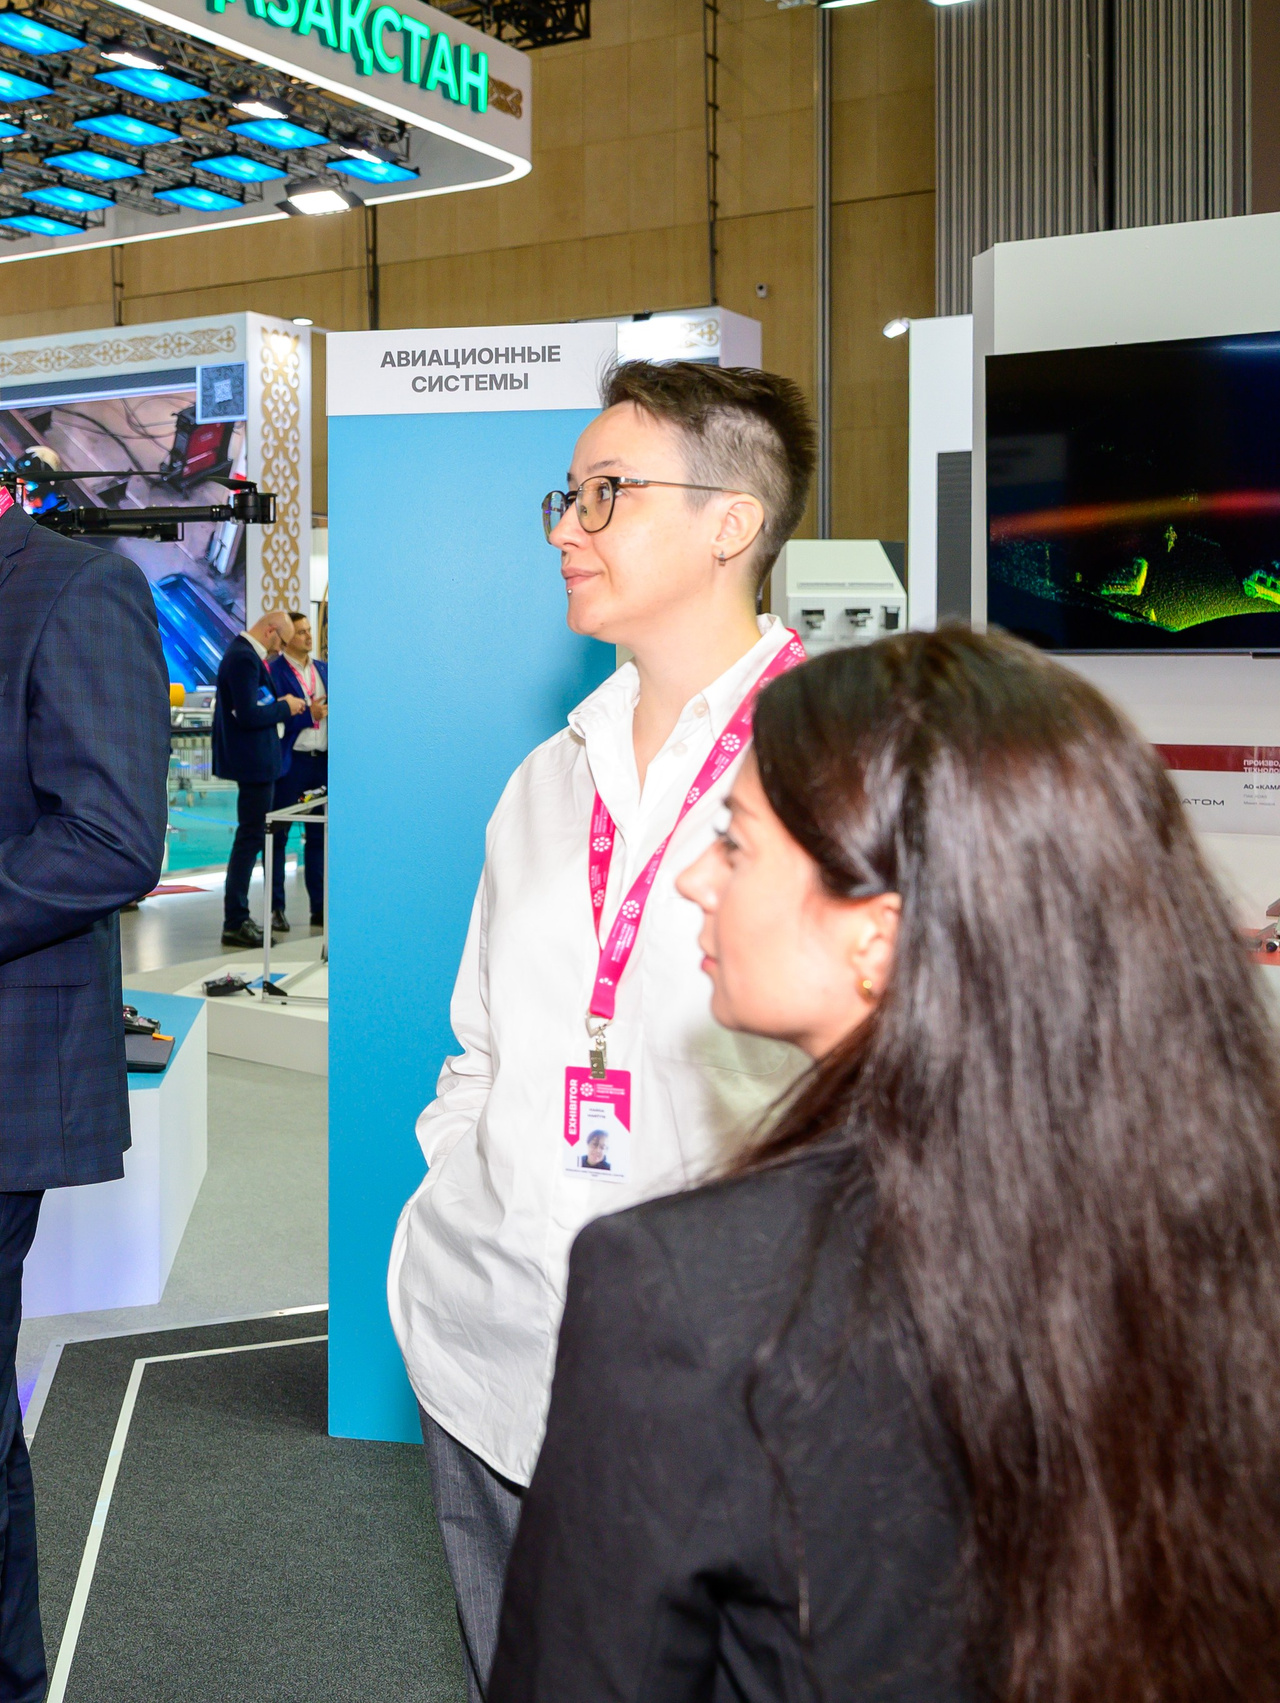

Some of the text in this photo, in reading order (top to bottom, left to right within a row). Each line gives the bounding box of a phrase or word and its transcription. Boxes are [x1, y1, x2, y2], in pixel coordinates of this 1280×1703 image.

[214, 0, 489, 113] АҚСТАН
[380, 345, 561, 369] АВИАЦИОННЫЕ
[411, 373, 529, 393] СИСТЕМЫ
[1243, 759, 1280, 768] ПРОИЗВО
[1243, 766, 1280, 774] ТЕХНОЛО
[568, 1079, 578, 1135] EXHIBITOR
